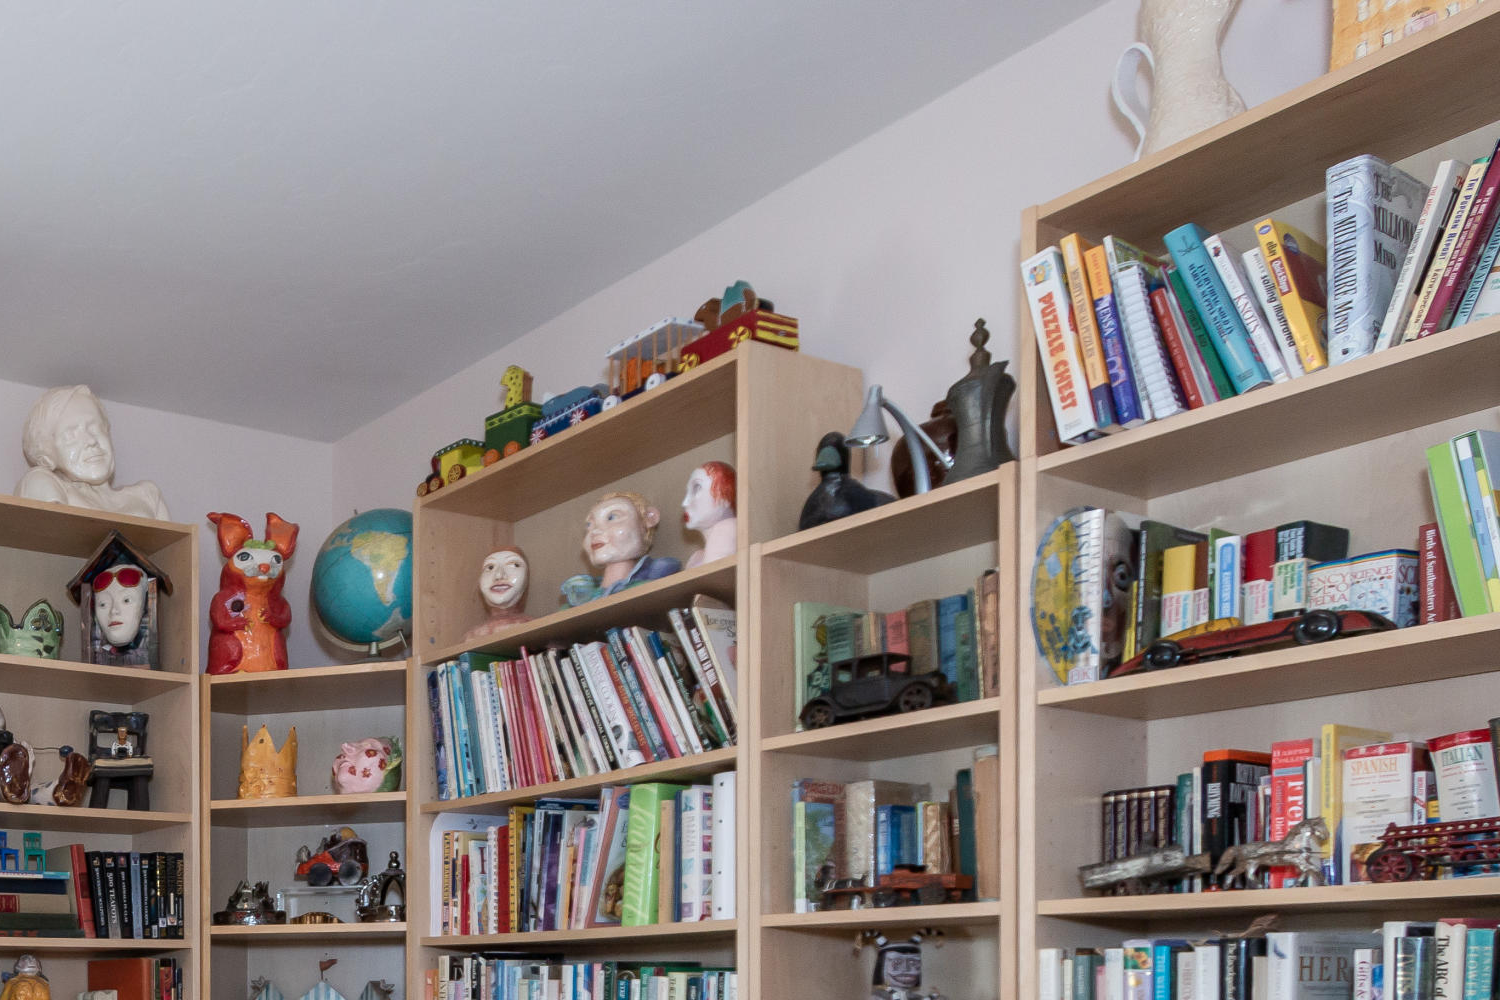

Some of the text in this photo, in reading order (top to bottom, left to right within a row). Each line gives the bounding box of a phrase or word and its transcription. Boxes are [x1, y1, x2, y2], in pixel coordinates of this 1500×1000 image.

[1450, 192, 1471, 231] POPCORN
[1334, 187, 1356, 334] THE MILLIONAIRE MIND
[1438, 230, 1456, 262] REPORT
[1257, 273, 1296, 347] sailing illustrated
[1038, 291, 1078, 410] PUZZLE CHEST
[1425, 529, 1435, 547] Birds
[1426, 560, 1436, 608] Southeastern
[1351, 757, 1398, 774] SPANISH
[1442, 745, 1484, 767] ITALIAN
[107, 888, 117, 923] TEAPOTS
[1436, 935, 1450, 956] The
[1434, 958, 1449, 984] ABC
[668, 978, 676, 994] THE
[1434, 986, 1447, 998] of
